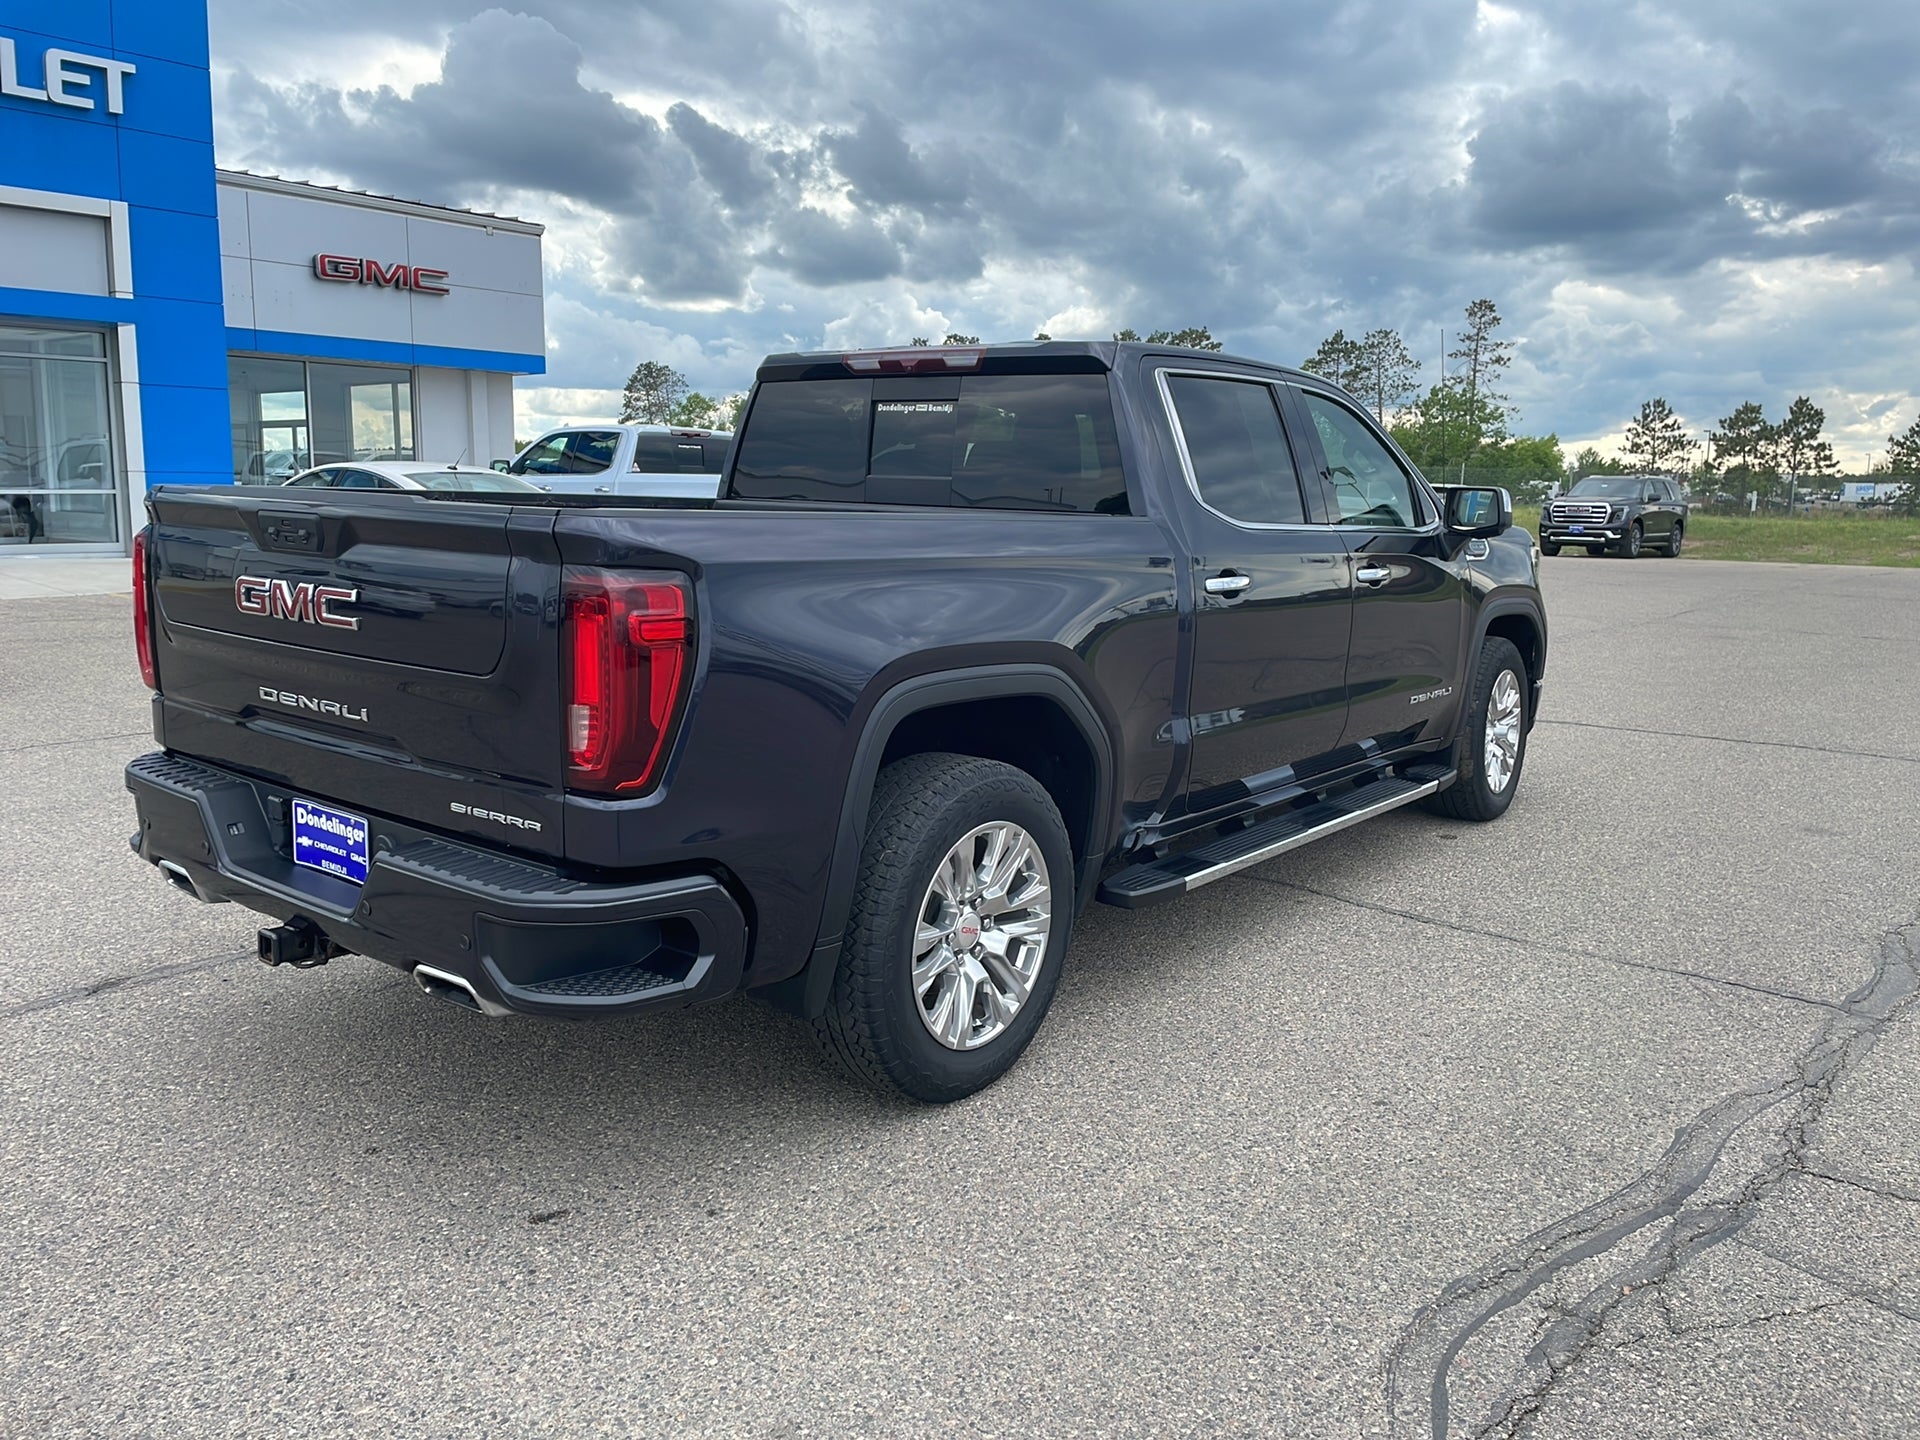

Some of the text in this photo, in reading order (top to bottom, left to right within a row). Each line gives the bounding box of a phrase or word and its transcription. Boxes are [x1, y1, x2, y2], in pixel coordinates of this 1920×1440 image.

[313, 253, 450, 296] GMC
[877, 403, 916, 414] Dondelinger
[234, 575, 361, 631] GMC
[258, 686, 369, 722] DENALI
[1409, 686, 1453, 705] DENALI
[296, 806, 365, 846] Dondelinger
[450, 802, 542, 832] SIERRA
[313, 840, 367, 866] CHEVROLET GMC
[961, 926, 979, 935] GMC
